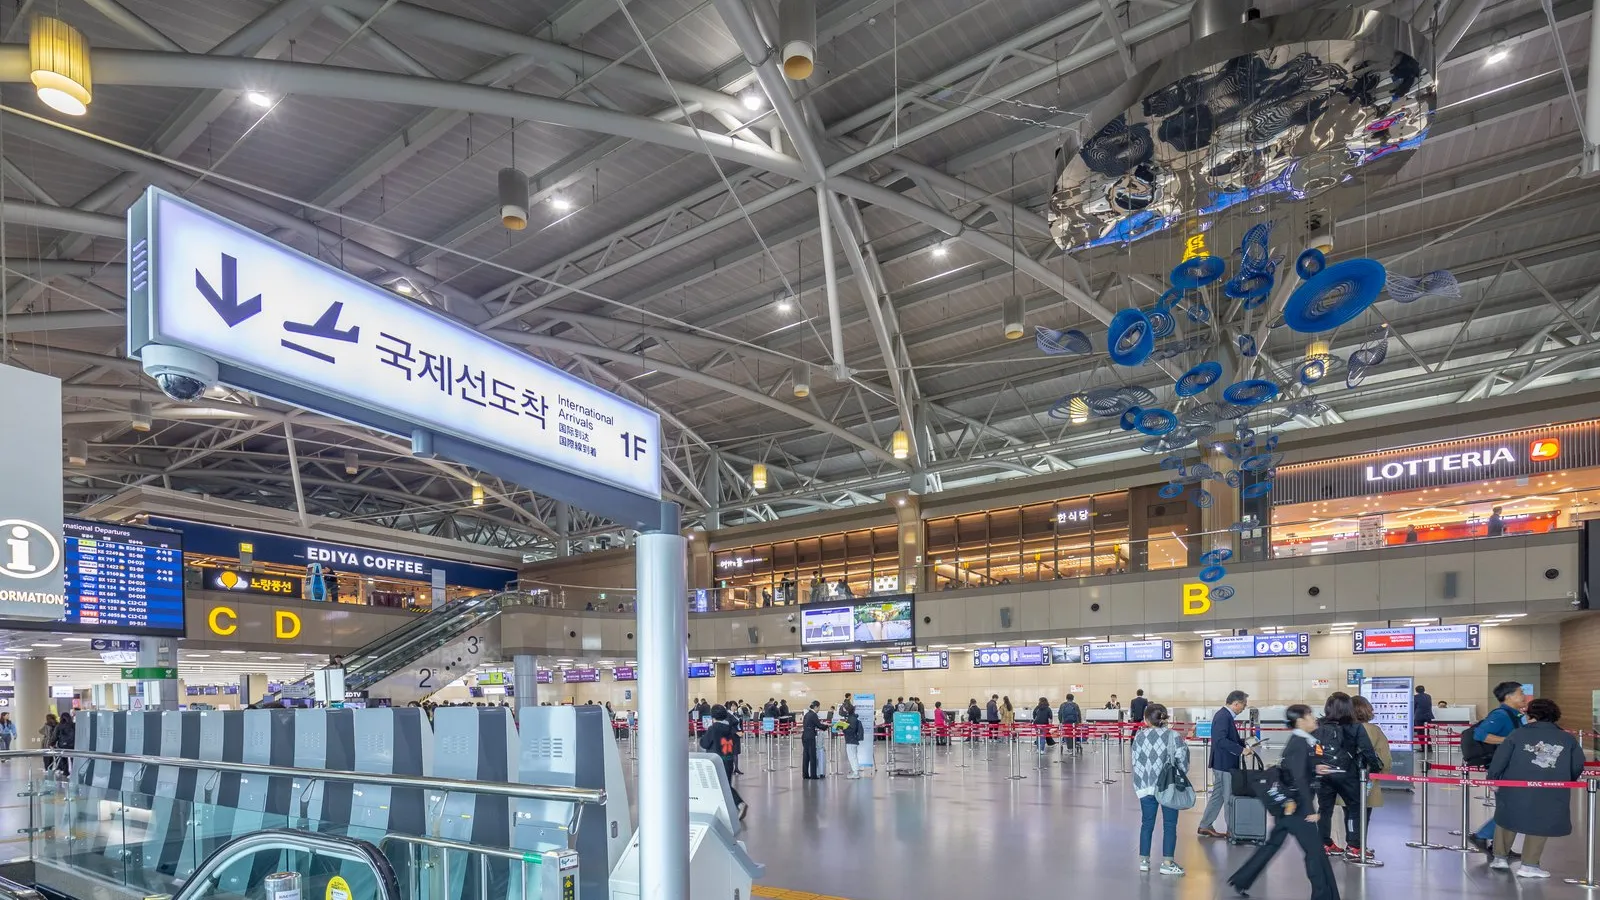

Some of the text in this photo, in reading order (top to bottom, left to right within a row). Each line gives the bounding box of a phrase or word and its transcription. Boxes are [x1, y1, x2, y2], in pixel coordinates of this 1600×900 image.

[376, 332, 548, 430] 국제선도착
[558, 394, 614, 426] International
[558, 410, 594, 430] Arrivals
[620, 432, 646, 460] 1F
[1366, 447, 1515, 481] LOTTERIA
[1058, 510, 1088, 523] 한식당
[94, 526, 130, 536] Departures
[307, 548, 424, 574] EDIYA COFFEE
[0, 590, 64, 604] ORMATION
[250, 578, 292, 593] 노랑풍선
[1183, 583, 1210, 615] B
[208, 606, 237, 636] C
[275, 610, 300, 639] D
[1470, 627, 1478, 635] B
